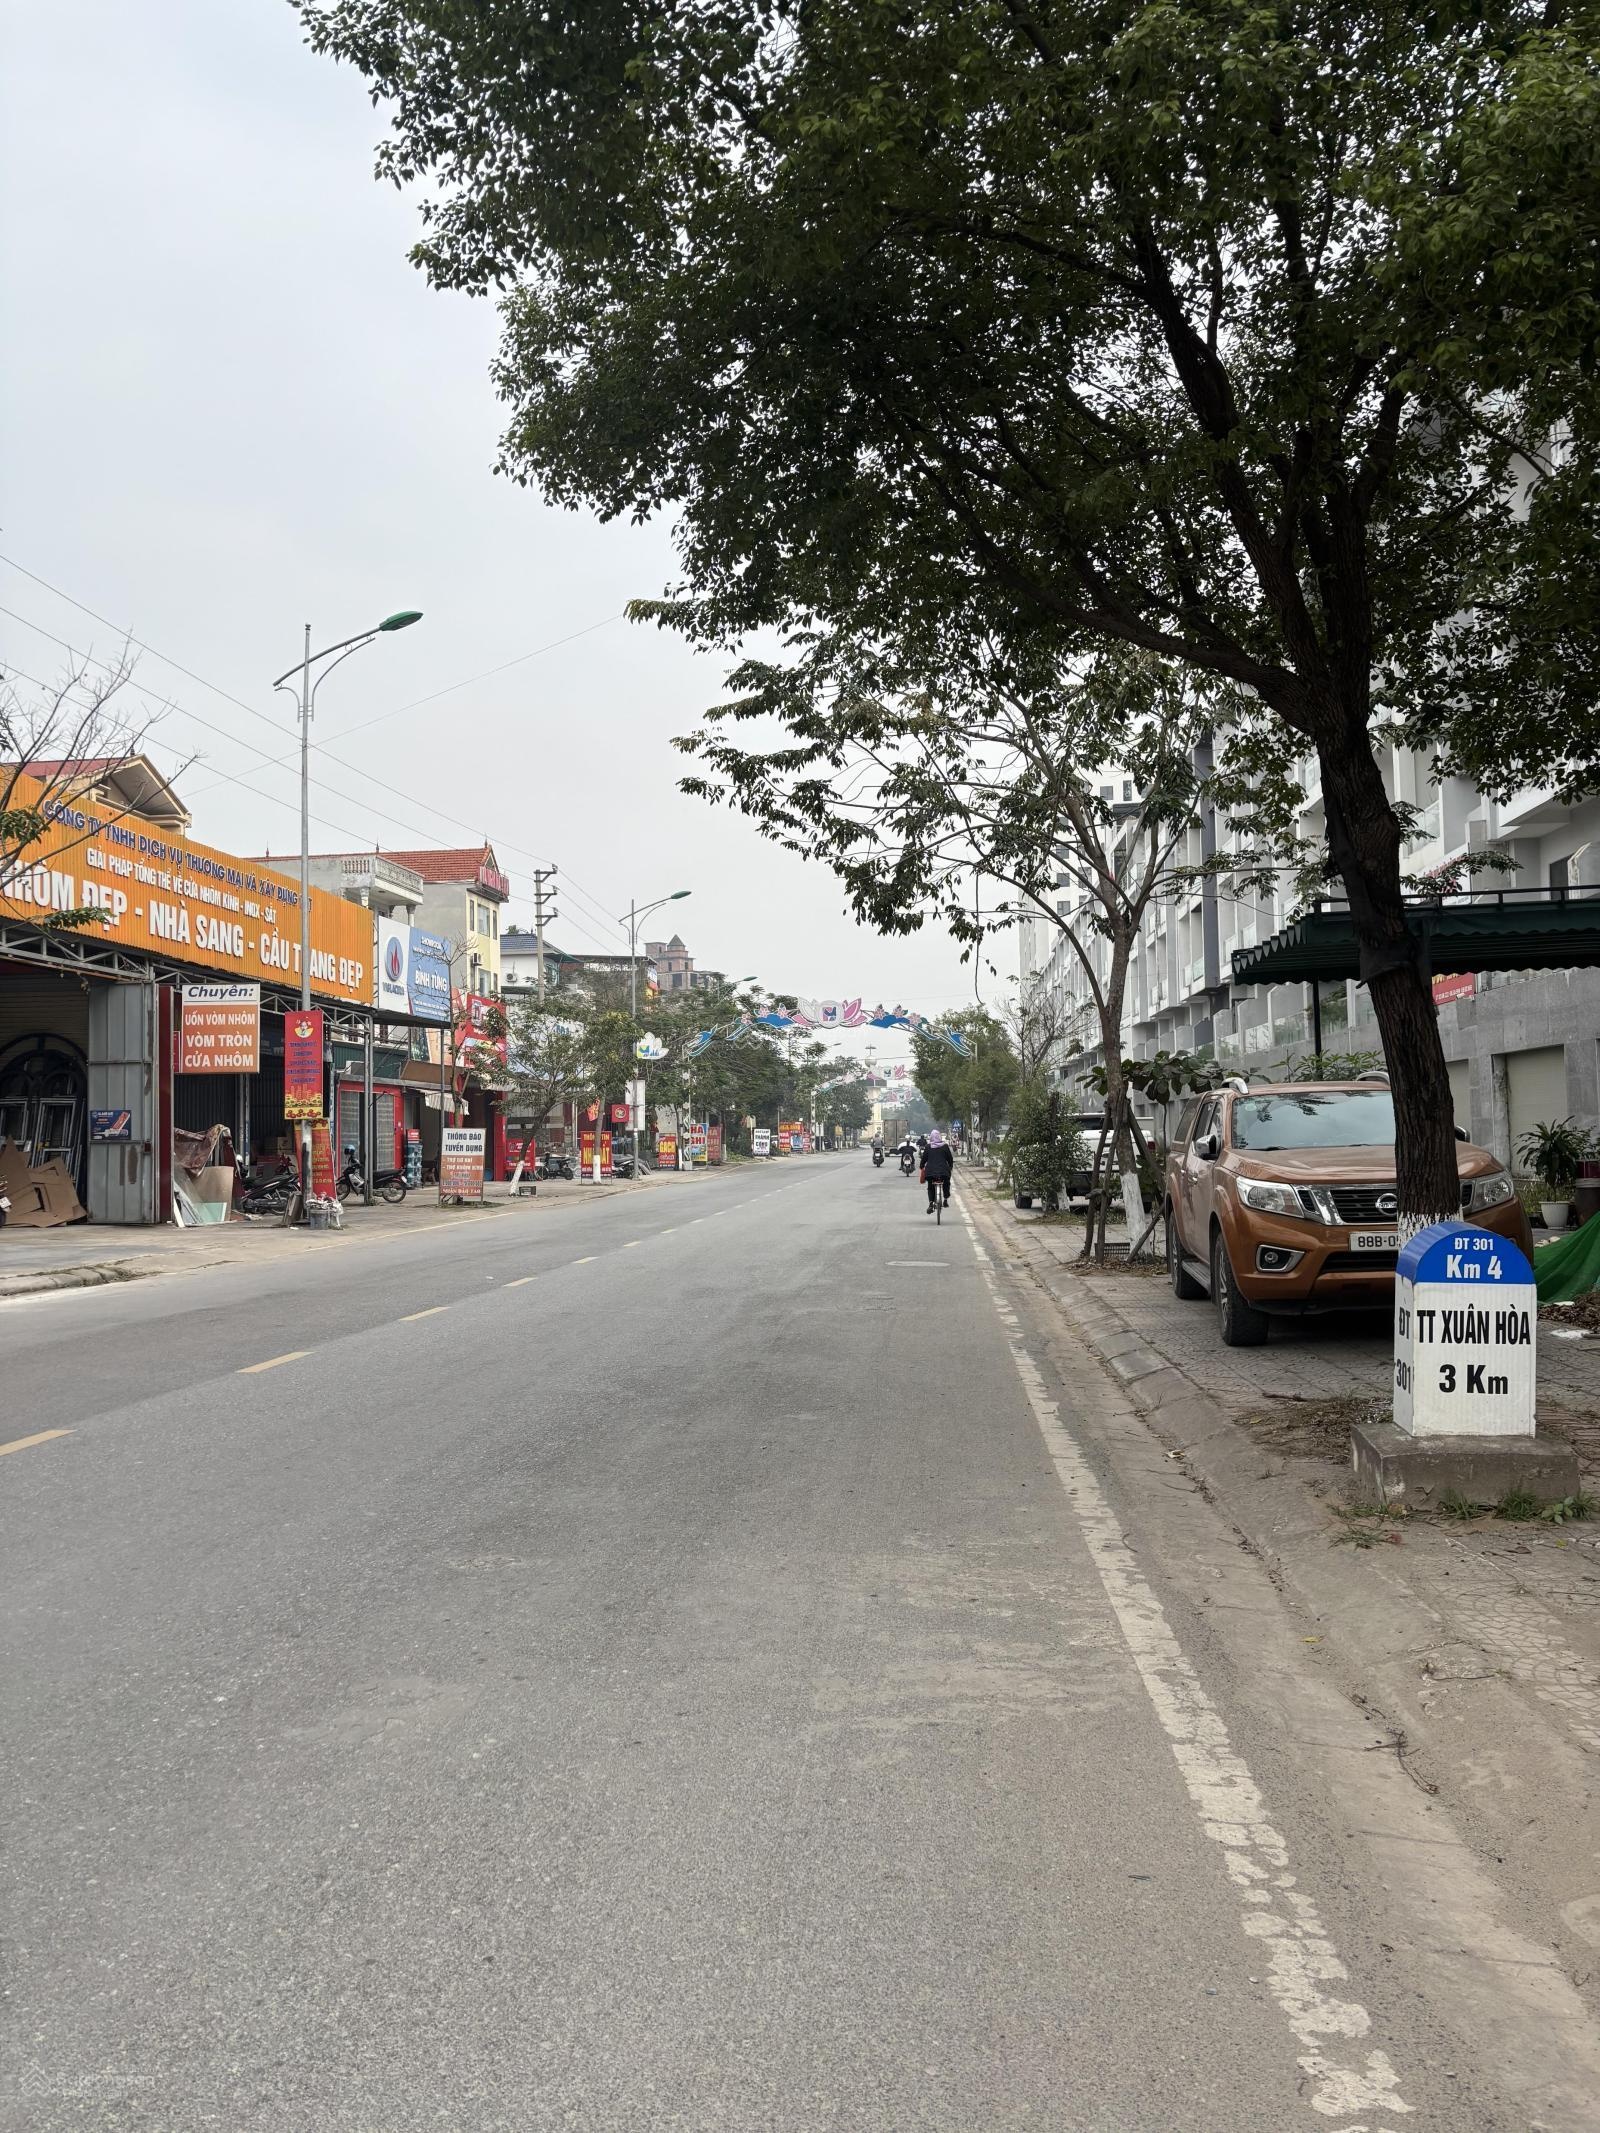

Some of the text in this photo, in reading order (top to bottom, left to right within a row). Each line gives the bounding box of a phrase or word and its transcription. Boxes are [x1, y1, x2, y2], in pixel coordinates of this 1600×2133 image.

[42, 800, 85, 830] CÔNG
[88, 816, 101, 837] TY
[105, 822, 136, 849] TNHH
[138, 834, 166, 861] DỊCH
[169, 846, 184, 871] VỤ
[227, 868, 244, 892] MẠI
[87, 845, 105, 870] GIẢI
[109, 854, 133, 878] PHÁP
[134, 858, 156, 884] TỔNG
[158, 868, 171, 890] THỂ
[222, 891, 239, 913] KÍNH
[150, 898, 190, 944] NHÀ
[195, 914, 244, 957] SANG
[260, 927, 290, 970] CẦU
[293, 943, 336, 982] TANG
[339, 956, 364, 993] ĐẸP
[188, 985, 254, 999] Chuyên:
[415, 965, 447, 992] BÌNH TÙNG
[185, 1010, 255, 1026] UỐN VÒM NHÔM
[186, 1031, 252, 1048] VÒM TRÒN
[184, 1051, 254, 1067] CỬA NHÔM
[1358, 1236, 1399, 1248] 88B-0
[1454, 1237, 1494, 1250] ĐT 301
[1446, 1254, 1502, 1279] Km 4
[1399, 1307, 1411, 1339] ĐT
[1417, 1303, 1531, 1345] TT XUÂN HÒA
[1396, 1359, 1411, 1394] 301
[1439, 1364, 1508, 1395] 3 Km
